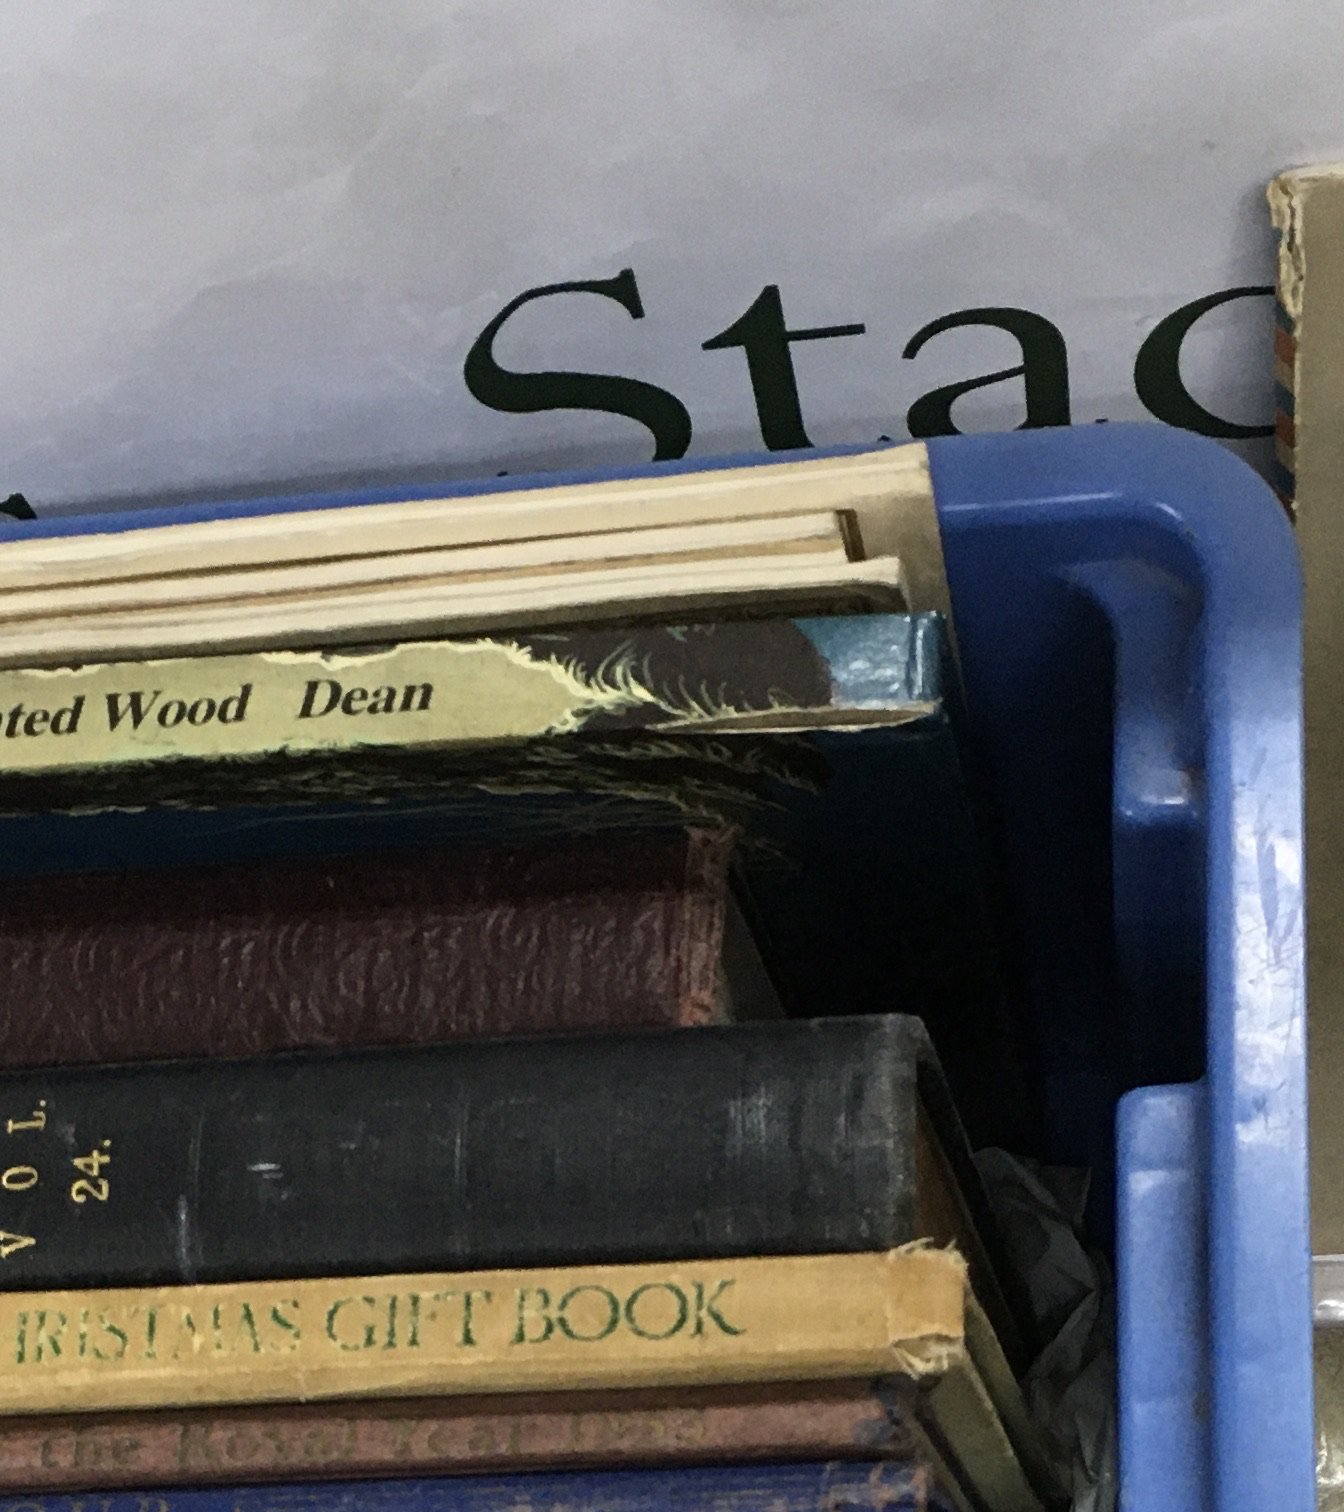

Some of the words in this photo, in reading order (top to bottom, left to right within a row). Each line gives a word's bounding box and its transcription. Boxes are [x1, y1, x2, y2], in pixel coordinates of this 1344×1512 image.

[104, 682, 254, 733] Wood
[297, 678, 436, 719] Dean
[324, 1288, 492, 1352] GIFT
[512, 1279, 747, 1345] BOOK
